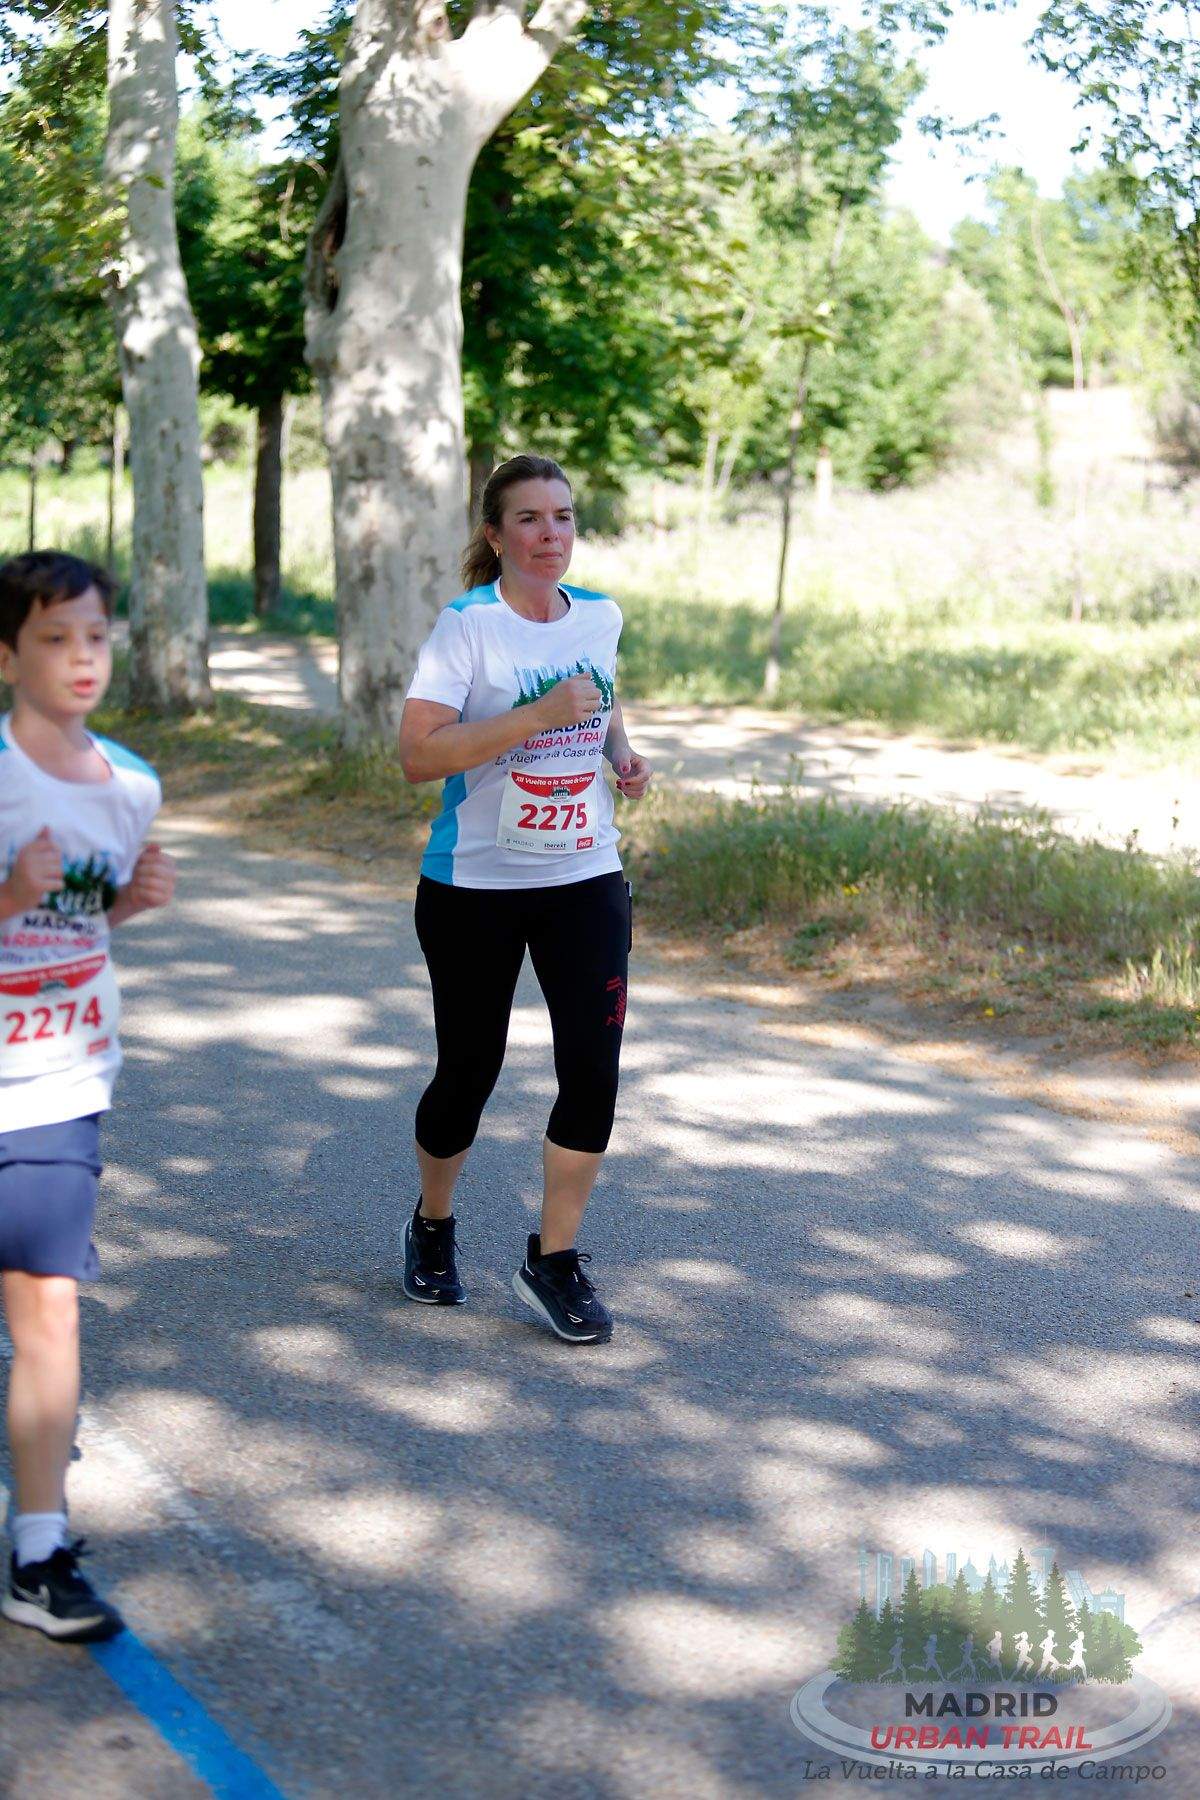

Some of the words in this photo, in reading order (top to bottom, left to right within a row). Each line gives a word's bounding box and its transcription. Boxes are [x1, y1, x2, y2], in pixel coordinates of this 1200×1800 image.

[524, 735, 575, 750] URBAN
[525, 777, 547, 786] Vuelta
[517, 802, 588, 831] 2275
[5, 995, 102, 1045] 2274
